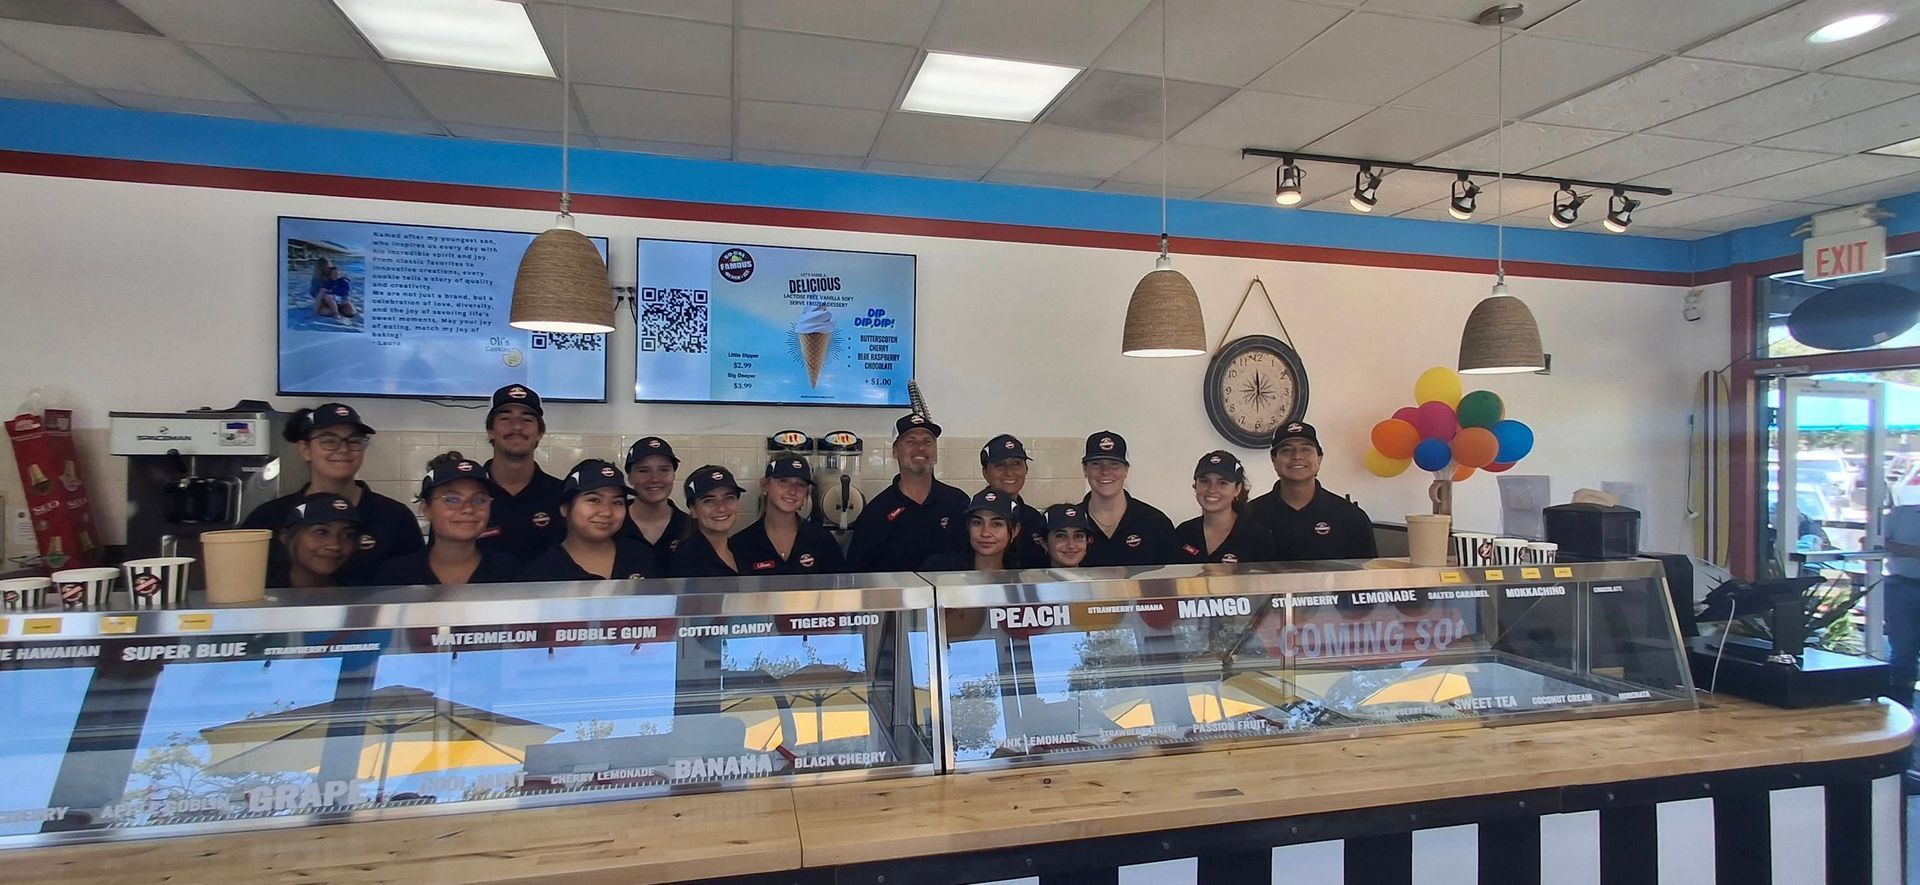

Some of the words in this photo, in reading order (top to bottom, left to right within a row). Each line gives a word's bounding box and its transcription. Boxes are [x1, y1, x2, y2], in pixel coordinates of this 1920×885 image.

[720, 260, 752, 270] FAMOUS
[1816, 241, 1868, 277] EXIT
[789, 277, 841, 293] DELICIOUS
[868, 308, 885, 317] DIP
[860, 335, 898, 343] BUTTERSCOTCH
[1352, 590, 1416, 605] LEMONADE
[1427, 591, 1454, 600] SALTED
[1456, 590, 1489, 598] CARAMEL
[1506, 586, 1566, 598] MOKKACHINO
[1088, 605, 1134, 614] STRAWBERRY
[1136, 604, 1163, 612] BANANA
[1178, 597, 1250, 619] MANGO
[790, 617, 835, 630] TIGERS
[839, 615, 879, 627] BLOOD
[990, 605, 1070, 629] PEACH
[555, 628, 617, 642] BUBBLE
[621, 626, 656, 640] GUM
[678, 624, 728, 638] COTTON
[732, 622, 773, 635] CANDY
[432, 629, 537, 647] WATERMELON
[1280, 620, 1404, 658] COMING
[16, 645, 100, 660] HAWAIIAN
[122, 645, 191, 662] SUPER
[195, 642, 247, 659] BLUE
[264, 645, 329, 655] STRAWBERRY
[330, 643, 381, 652] LEMONADE
[1454, 697, 1495, 710] SWEET
[1496, 696, 1517, 708] TEA
[1532, 695, 1566, 705] COCONUT
[1568, 693, 1592, 703] CREAM
[1192, 721, 1234, 734] PASSION
[1237, 719, 1267, 730] FRUIT
[1024, 734, 1079, 747] LEMONADE
[675, 754, 773, 779] BANANA
[794, 756, 835, 769] BLACK
[838, 751, 887, 765] CHERRY
[550, 772, 594, 784] CHERRY
[597, 767, 655, 780] LEMONADE
[250, 780, 366, 812] GRAPE
